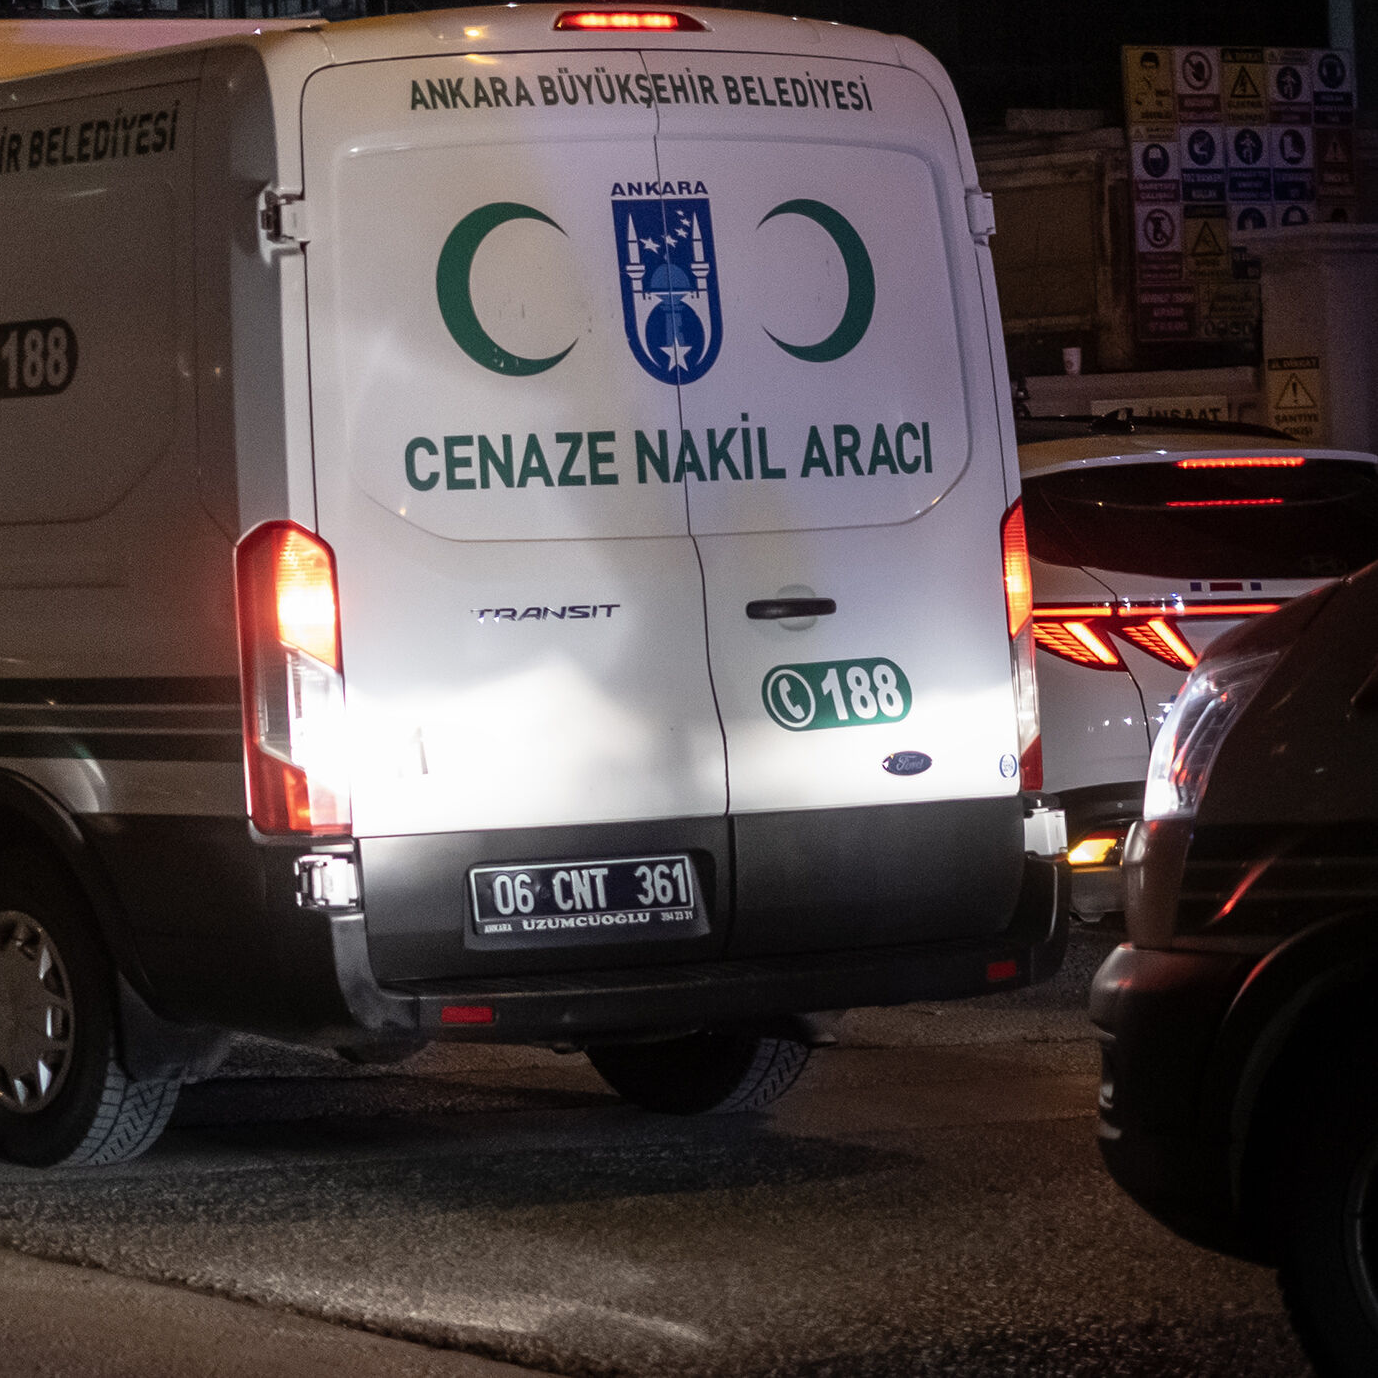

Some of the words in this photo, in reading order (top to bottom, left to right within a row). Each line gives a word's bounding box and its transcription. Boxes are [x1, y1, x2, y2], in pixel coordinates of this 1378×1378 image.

[410, 75, 536, 111] ANKARA
[537, 66, 720, 110] BÜYÜKŞEHİR
[721, 70, 874, 112] BELEDİYESİ
[28, 99, 181, 172] BELEDİYESİ
[610, 180, 709, 197] ANKARA
[1, 326, 69, 390] 188
[404, 430, 619, 492] CENAZE
[635, 412, 786, 484] NAKİL
[801, 422, 933, 478] ARACI
[470, 604, 620, 623] TRANSIT
[821, 664, 904, 721] 188
[896, 756, 924, 772] Ford
[492, 873, 534, 915] 06
[552, 868, 609, 912] CNT
[634, 863, 687, 906] 361
